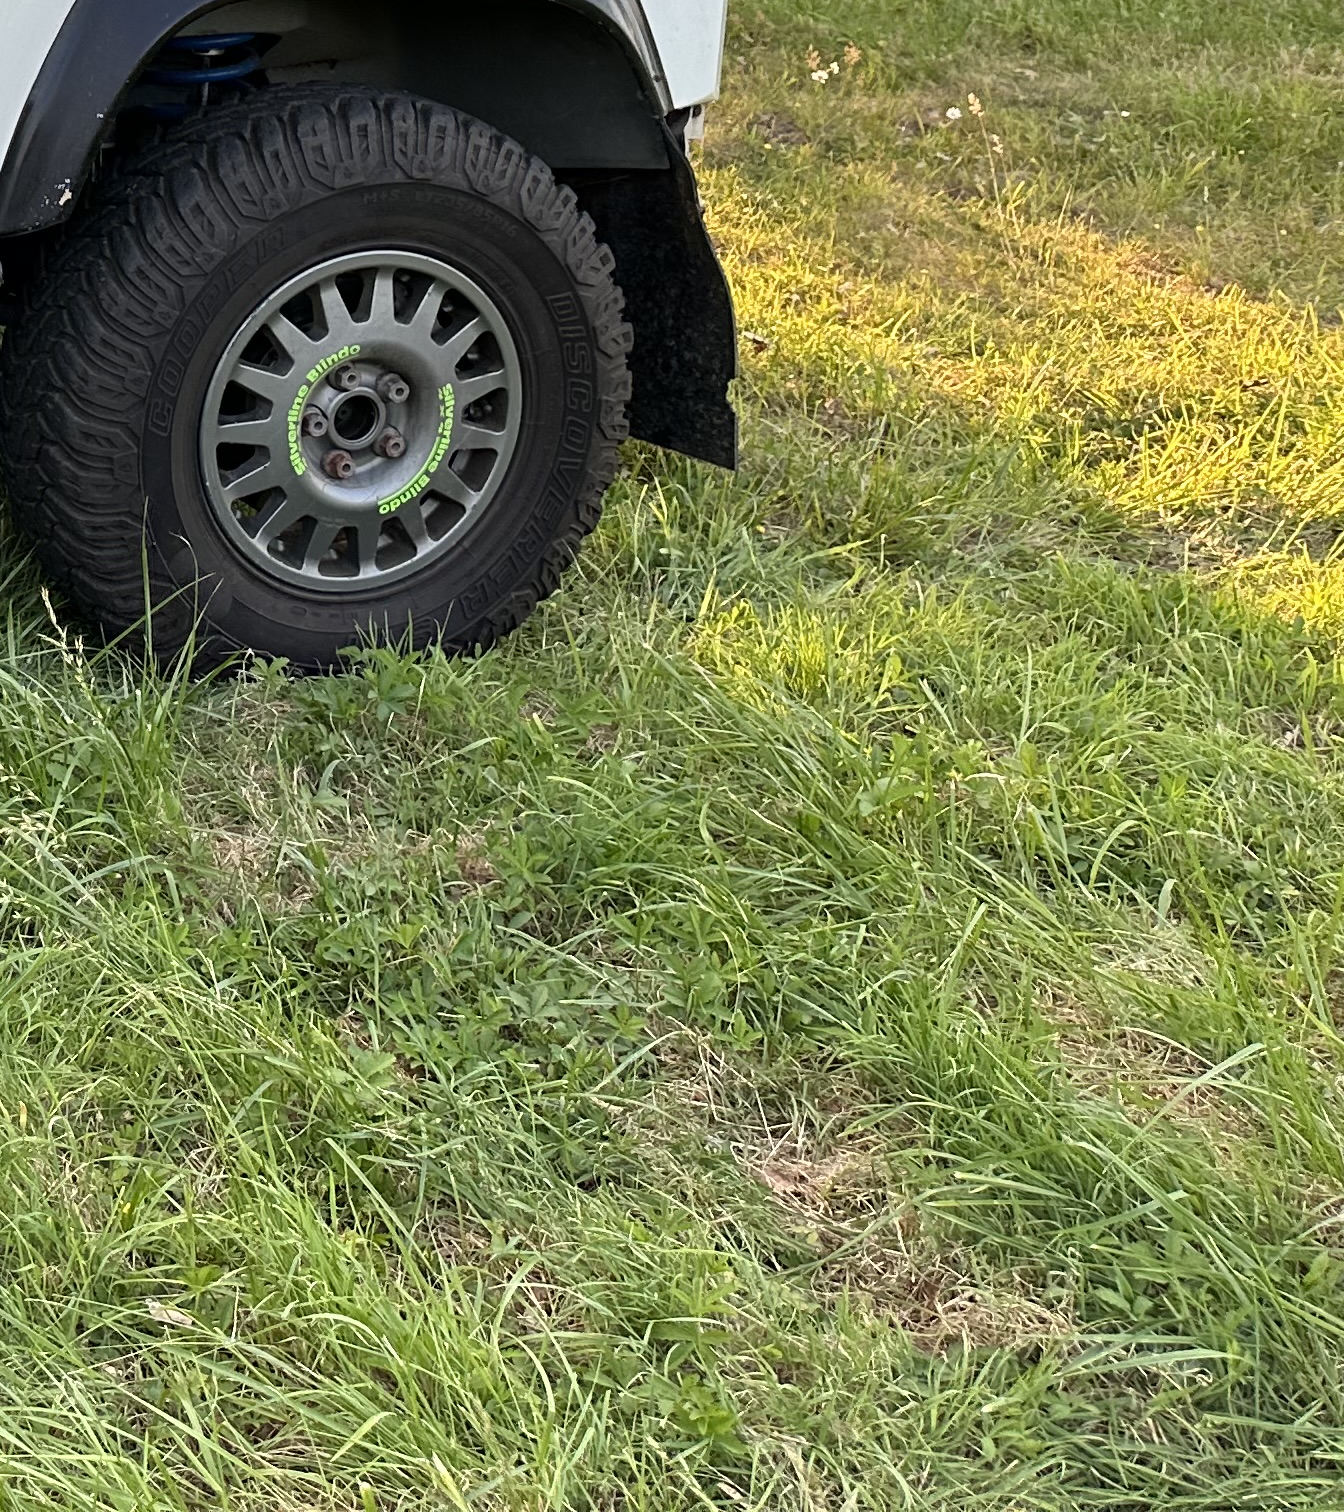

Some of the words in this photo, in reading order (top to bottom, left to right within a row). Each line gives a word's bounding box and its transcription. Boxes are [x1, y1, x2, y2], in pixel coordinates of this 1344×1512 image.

[148, 227, 286, 438] COOPER
[287, 384, 309, 476] Silverline
[306, 344, 361, 382] Blindo
[428, 383, 455, 473] Silverline
[459, 291, 594, 620] DISCOVERER
[379, 474, 431, 515] Blindo
